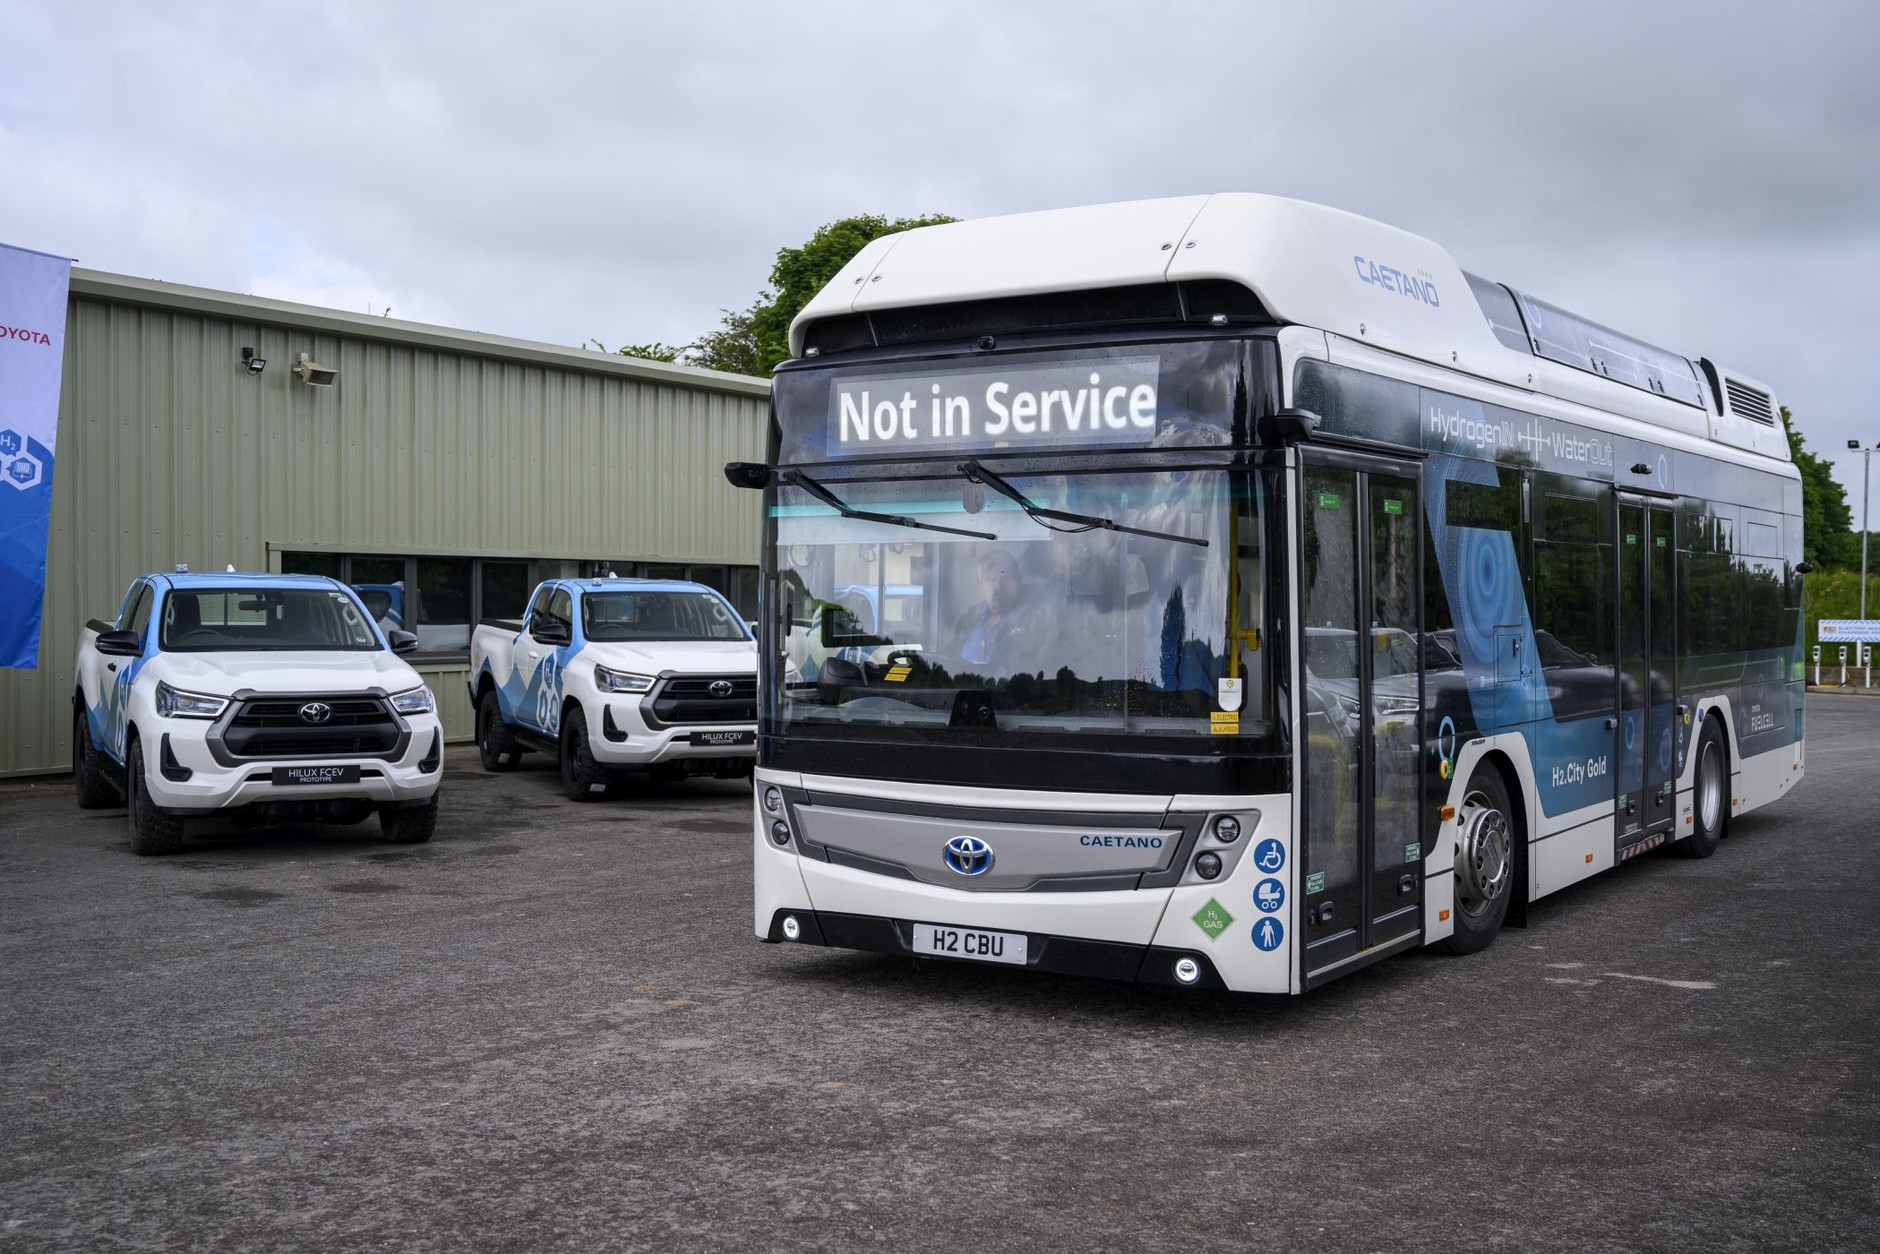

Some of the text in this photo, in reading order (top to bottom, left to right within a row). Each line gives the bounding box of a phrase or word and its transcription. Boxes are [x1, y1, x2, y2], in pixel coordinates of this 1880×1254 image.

[1353, 255, 1440, 308] CAETANO
[839, 372, 1156, 442] Not in Service
[288, 767, 344, 778] HILUX FCEV
[1587, 755, 1607, 778] Gold
[1080, 835, 1163, 848] CAETANO
[1208, 910, 1219, 920] H2
[1203, 920, 1223, 929] GAS
[933, 929, 1004, 957] H2 CBU
